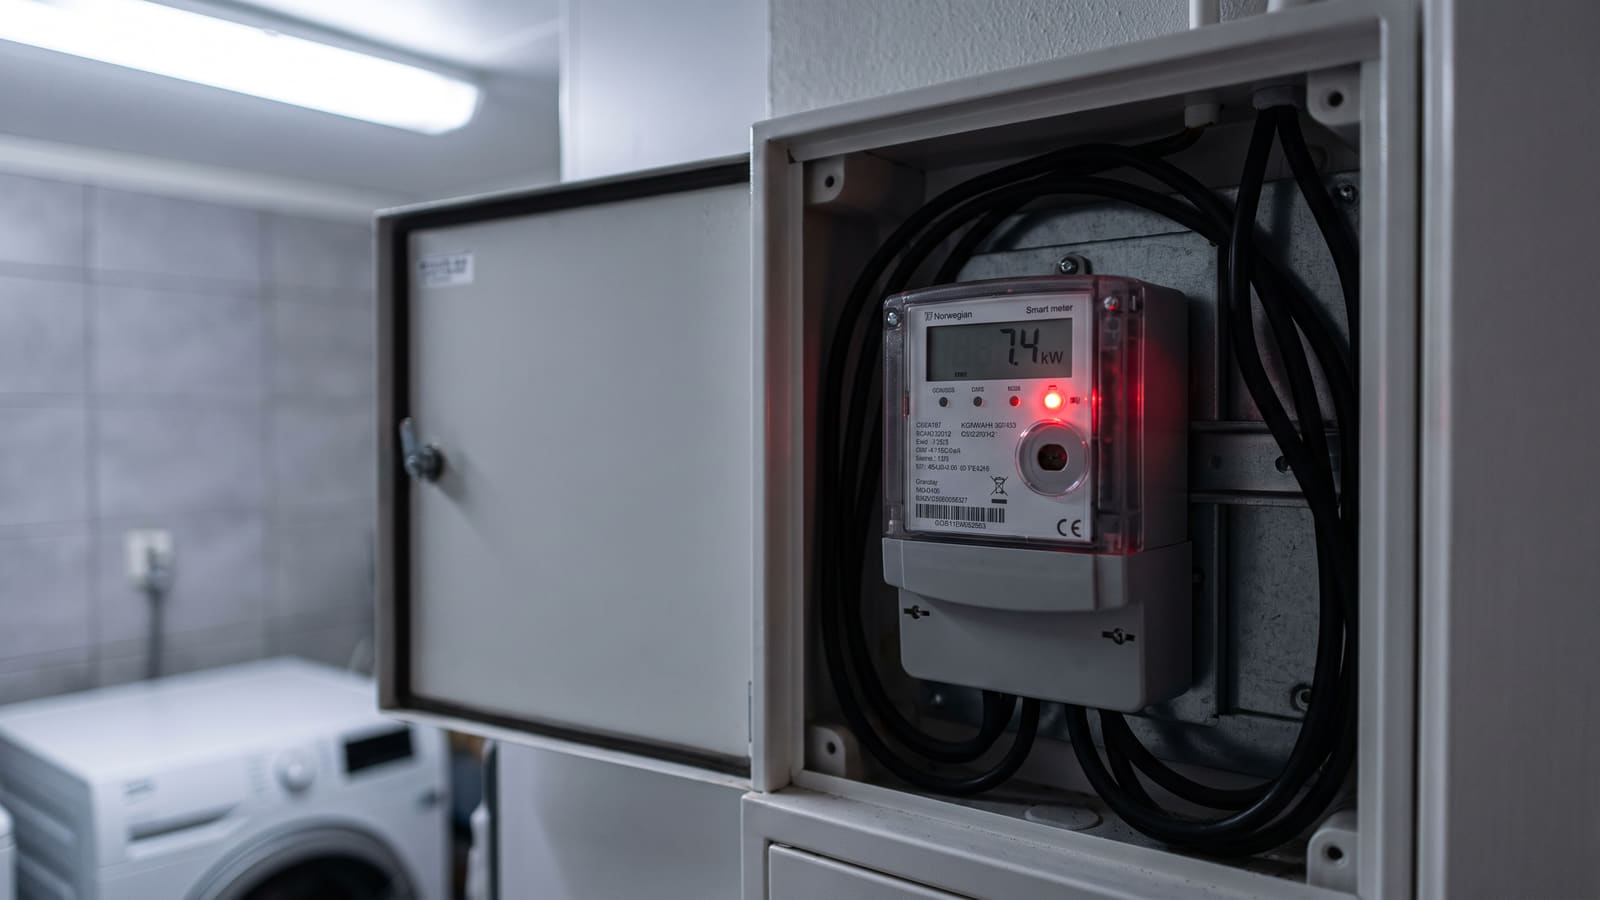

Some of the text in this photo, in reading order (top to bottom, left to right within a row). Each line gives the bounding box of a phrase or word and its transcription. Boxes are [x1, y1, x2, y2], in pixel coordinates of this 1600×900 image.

[934, 310, 973, 321] Norwegian
[1026, 304, 1073, 314] Smart meter
[1000, 328, 1063, 366] 7.4 kW
[1057, 519, 1081, 537] CE
